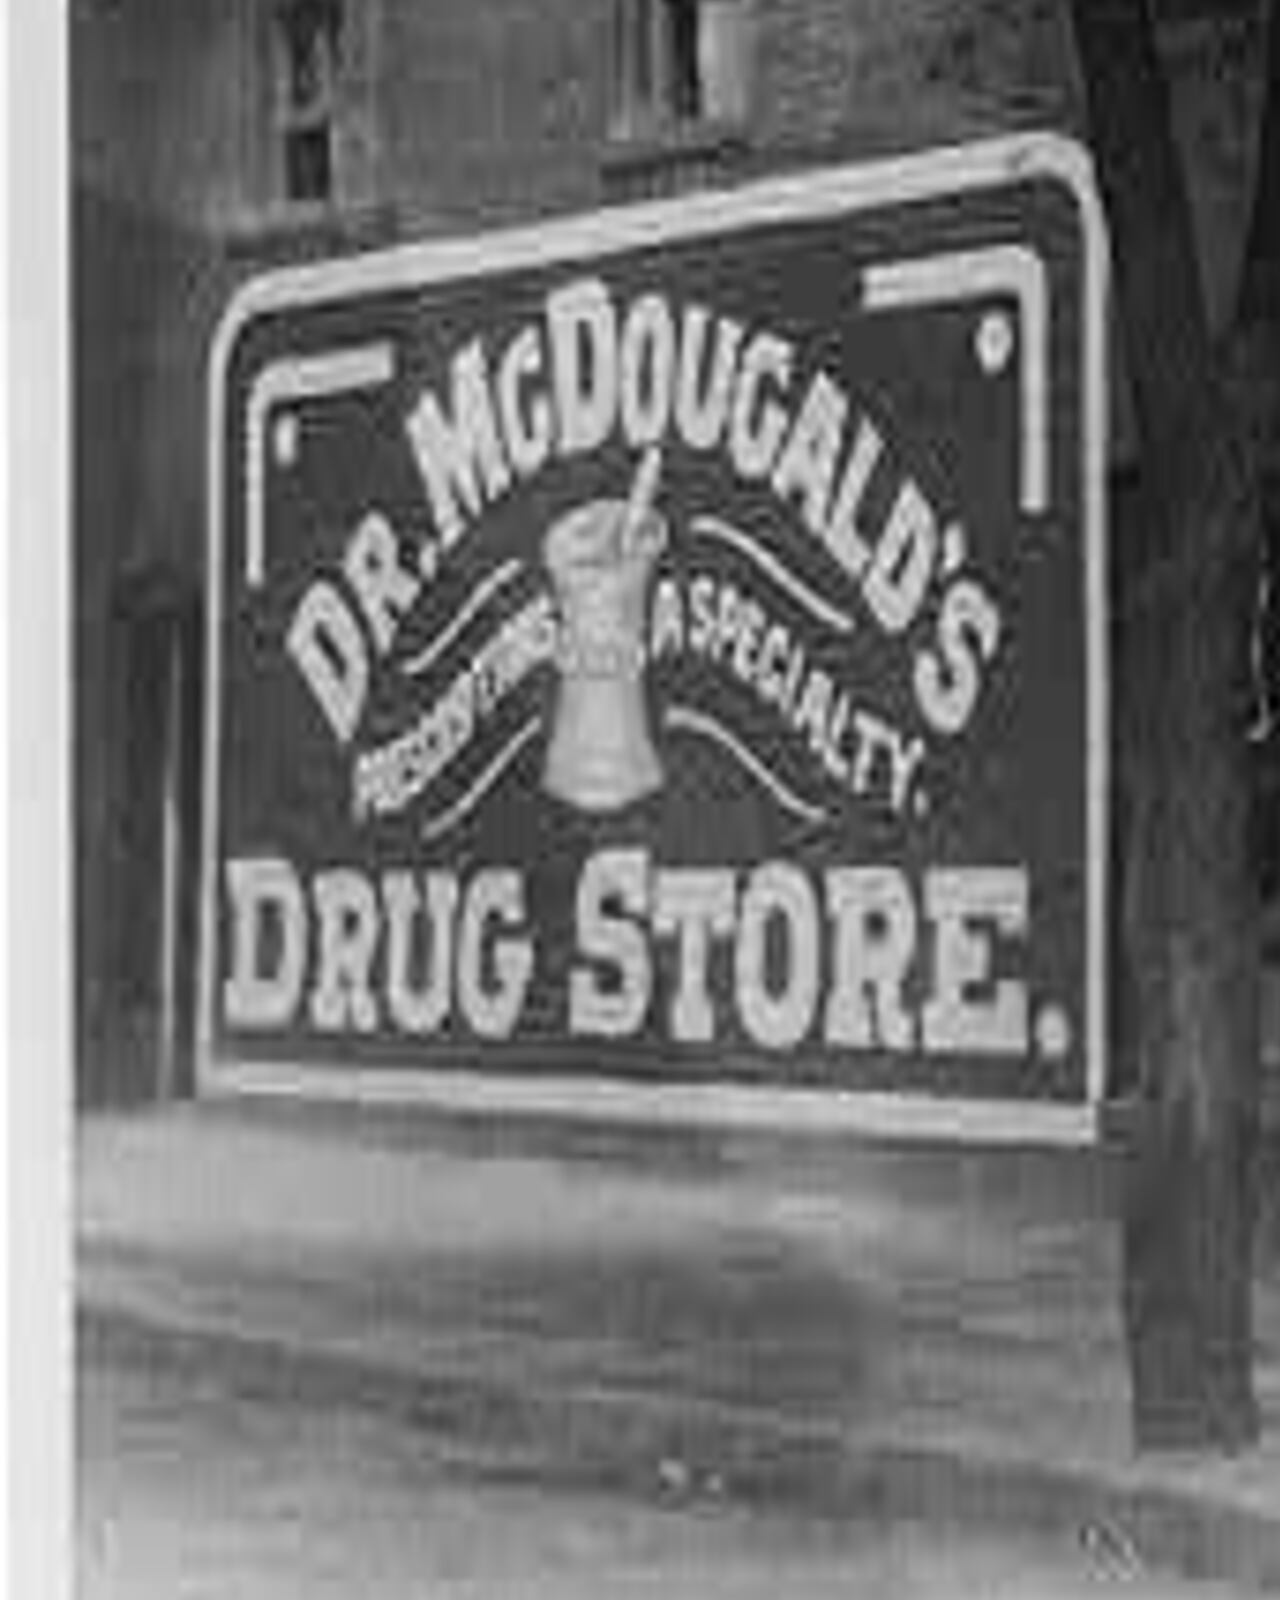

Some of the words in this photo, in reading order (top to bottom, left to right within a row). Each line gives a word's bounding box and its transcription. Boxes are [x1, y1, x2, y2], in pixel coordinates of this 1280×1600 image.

[286, 512, 436, 742] DR.
[652, 580, 684, 658] A
[223, 857, 534, 1042] DRUG
[568, 848, 1072, 1060] STORE.
